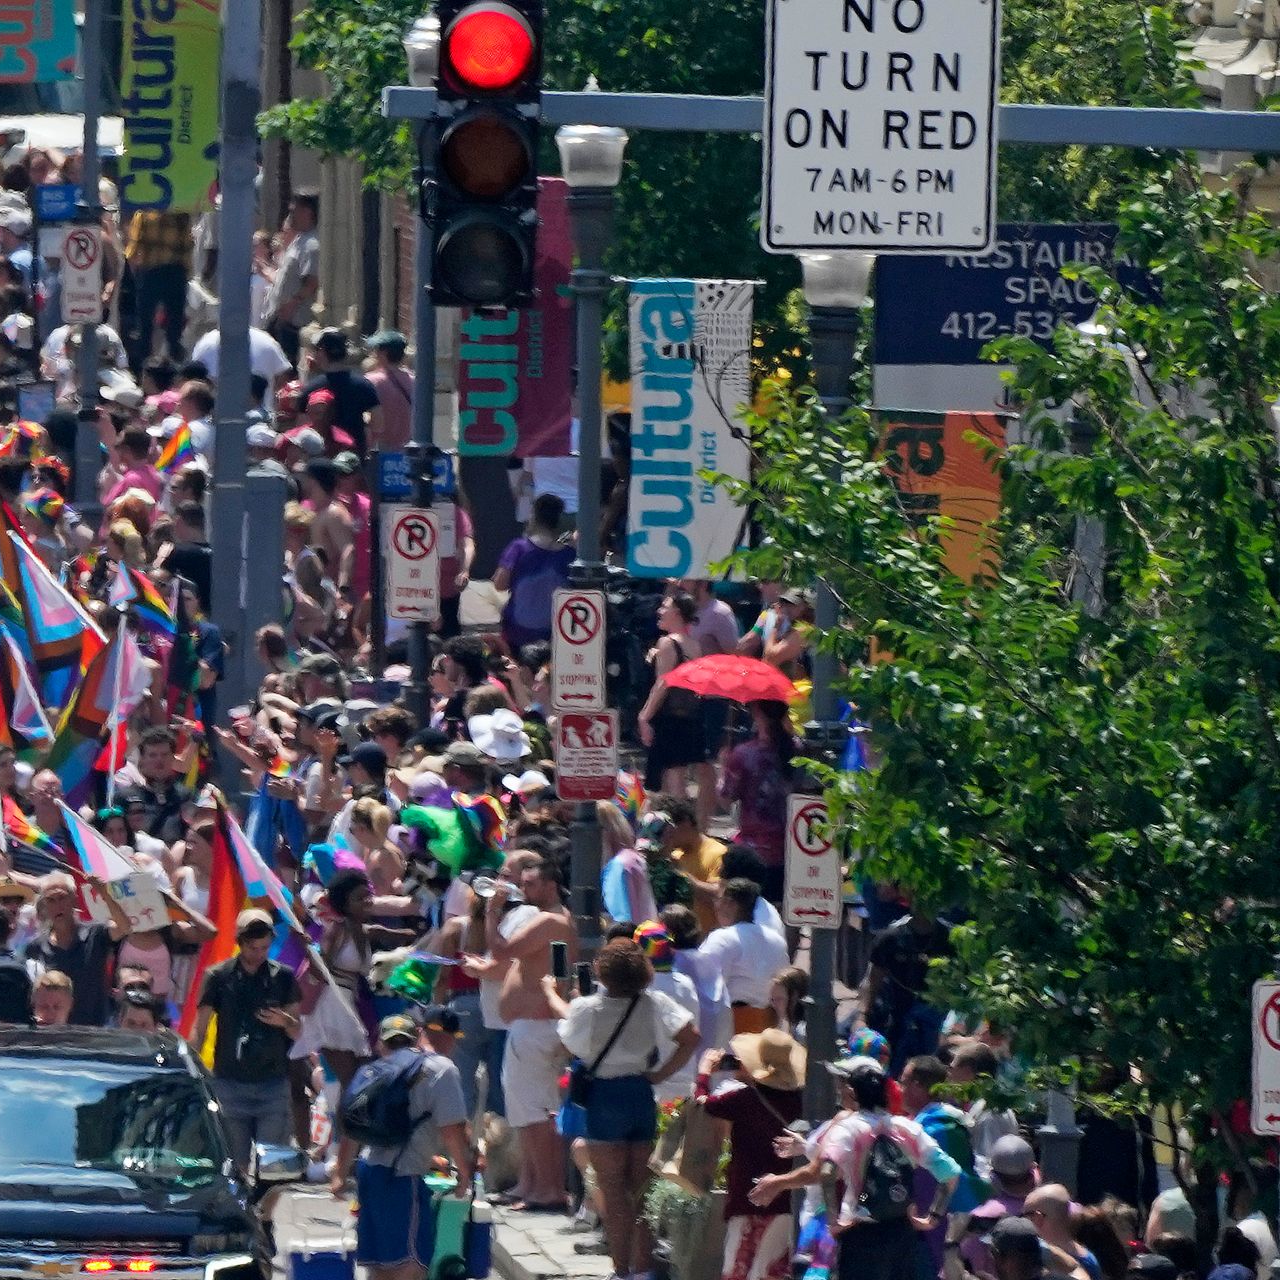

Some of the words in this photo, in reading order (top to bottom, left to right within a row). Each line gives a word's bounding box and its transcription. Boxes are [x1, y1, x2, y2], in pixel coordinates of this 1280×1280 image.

[842, 0, 924, 33] NO
[805, 51, 961, 92] TURN
[785, 108, 848, 149] ON
[883, 109, 977, 150] RED
[813, 211, 944, 236] MON-FRI
[1005, 277, 1098, 305] SPAC
[626, 281, 696, 579] Cultural
[698, 431, 718, 504] Dirict
